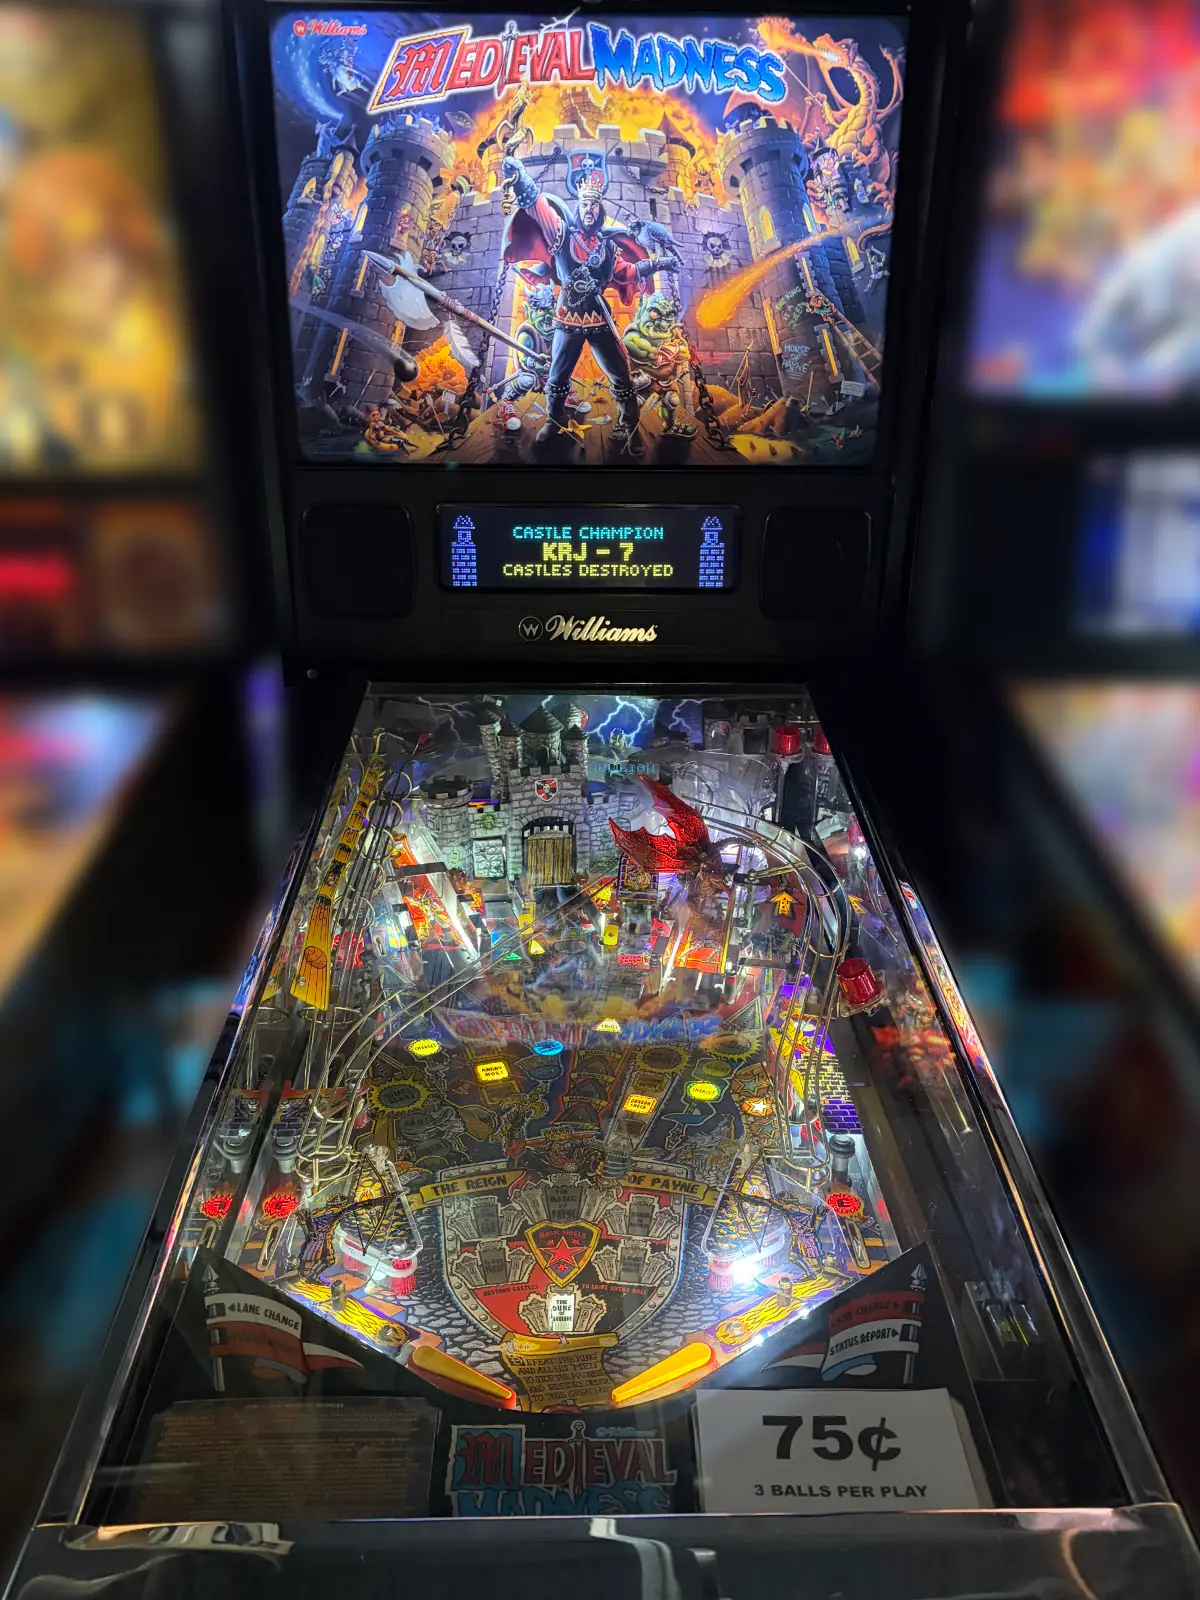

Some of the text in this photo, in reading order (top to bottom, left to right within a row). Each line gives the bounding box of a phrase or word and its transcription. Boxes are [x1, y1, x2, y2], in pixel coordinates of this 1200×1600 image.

[307, 18, 367, 36] Williams
[382, 24, 787, 103] MEDIEVAL MADNESS
[784, 285, 802, 300] KING
[784, 343, 811, 355] HOUSE
[782, 359, 809, 373] PAYNE
[512, 526, 664, 540] CASTLE CHAMPION
[542, 542, 587, 561] KRJ
[620, 542, 634, 561] 7
[502, 563, 674, 577] CASTLES DESTROYED
[545, 614, 658, 642] Williams
[431, 1174, 507, 1197] THE REIGN
[627, 1173, 699, 1194] OF PAYNE
[512, 1284, 539, 1292] CASTLES
[552, 1304, 573, 1312] DUKE
[236, 1301, 300, 1331] LANE CHANGE
[829, 1327, 891, 1356] STATUS REPORT
[518, 1367, 536, 1375] AND
[523, 1376, 533, 1384] TO
[529, 1385, 546, 1394] AND
[530, 1394, 544, 1402] TO
[761, 1415, 902, 1472] 75¢
[456, 1422, 677, 1490] MEDIEVAL
[754, 1484, 928, 1498] 3 BALLS PER PLAY
